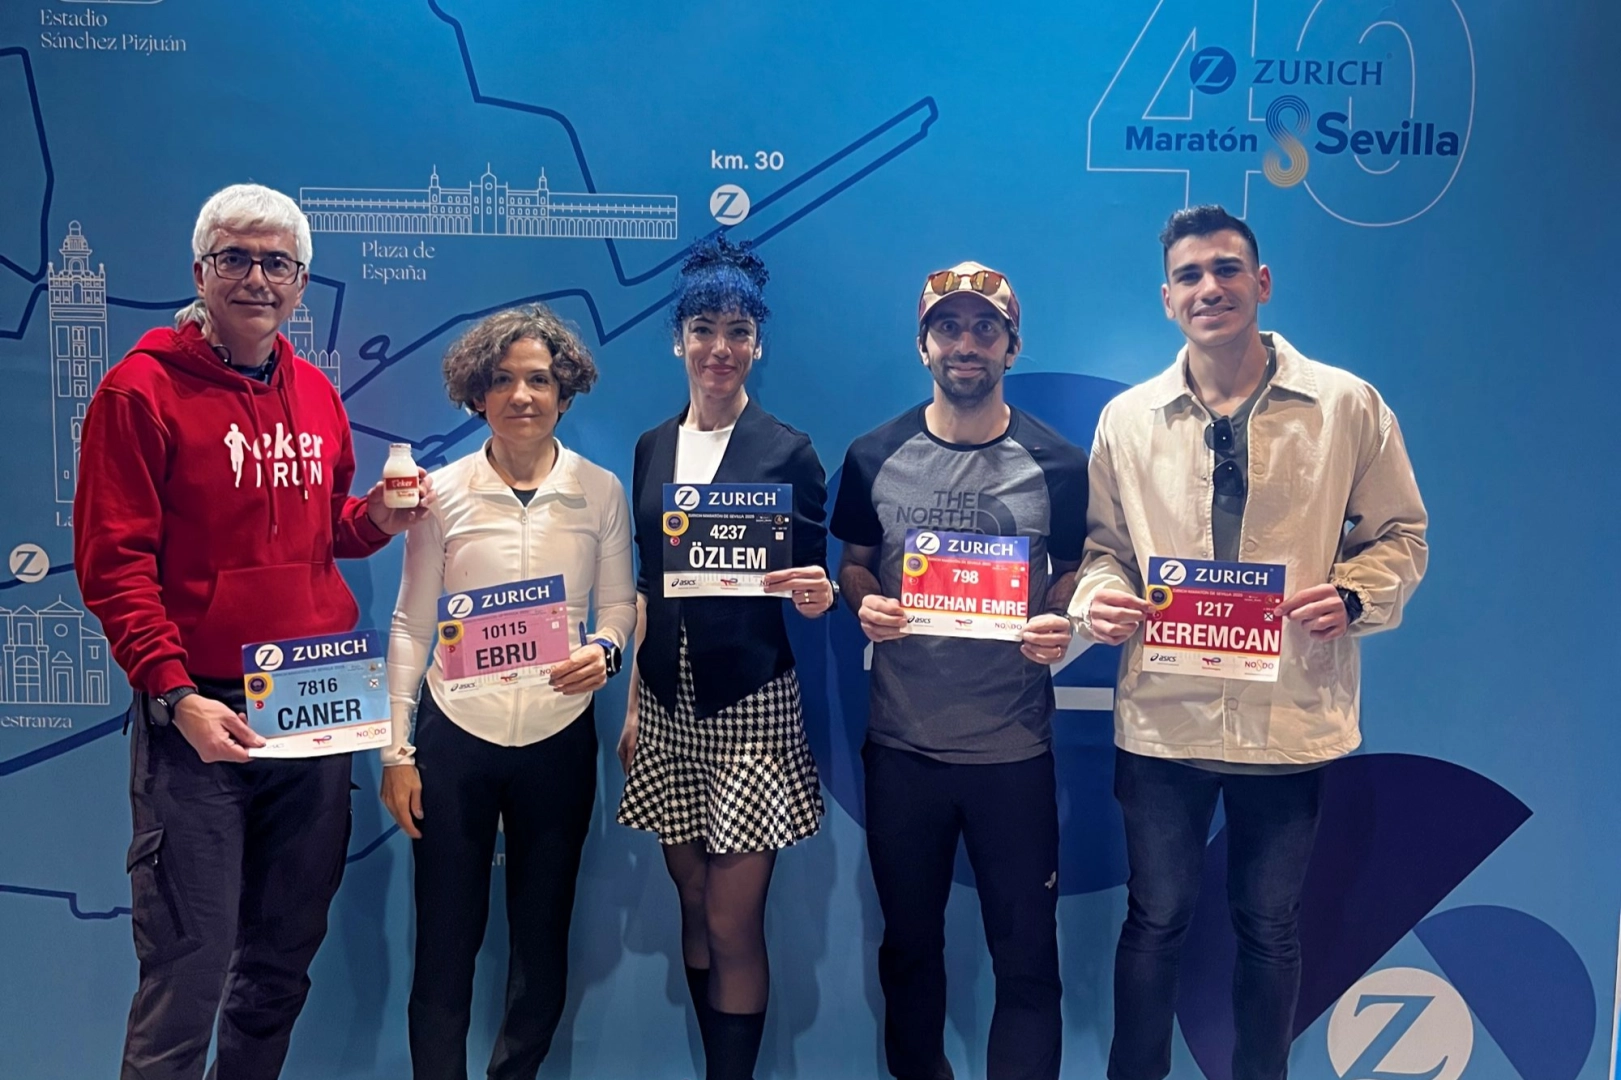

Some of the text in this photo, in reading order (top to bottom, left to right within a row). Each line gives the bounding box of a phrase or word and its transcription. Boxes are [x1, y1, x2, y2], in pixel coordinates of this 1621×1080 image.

[41, 8, 107, 27] Estadio
[41, 30, 186, 56] Sánchez Pizjuán
[1253, 59, 1383, 86] ZURICH
[1125, 111, 1459, 157] Maratón Sevilla
[711, 149, 784, 171] km. 30
[362, 240, 436, 259] Plaza de
[362, 263, 426, 285] España
[253, 422, 323, 461] eker
[273, 461, 323, 488] RUN
[708, 491, 776, 506] ZURICH
[933, 490, 976, 510] THE
[896, 506, 975, 528] NORTH
[710, 524, 746, 540] 4237
[689, 541, 767, 570] ÖZLEM
[948, 539, 1014, 556] ZURICH
[952, 569, 979, 584] 798
[1194, 568, 1268, 586] ZURICH
[481, 585, 550, 609] ZURICH
[902, 592, 1027, 616] OGUZHAN EMRE
[1195, 601, 1234, 618] 1217
[482, 621, 527, 640] 10115
[1145, 620, 1280, 653] KEREMCAN
[292, 638, 368, 662] ZURICH
[475, 640, 537, 670] EBRU
[297, 677, 338, 697] 7816
[277, 698, 362, 731] CANER
